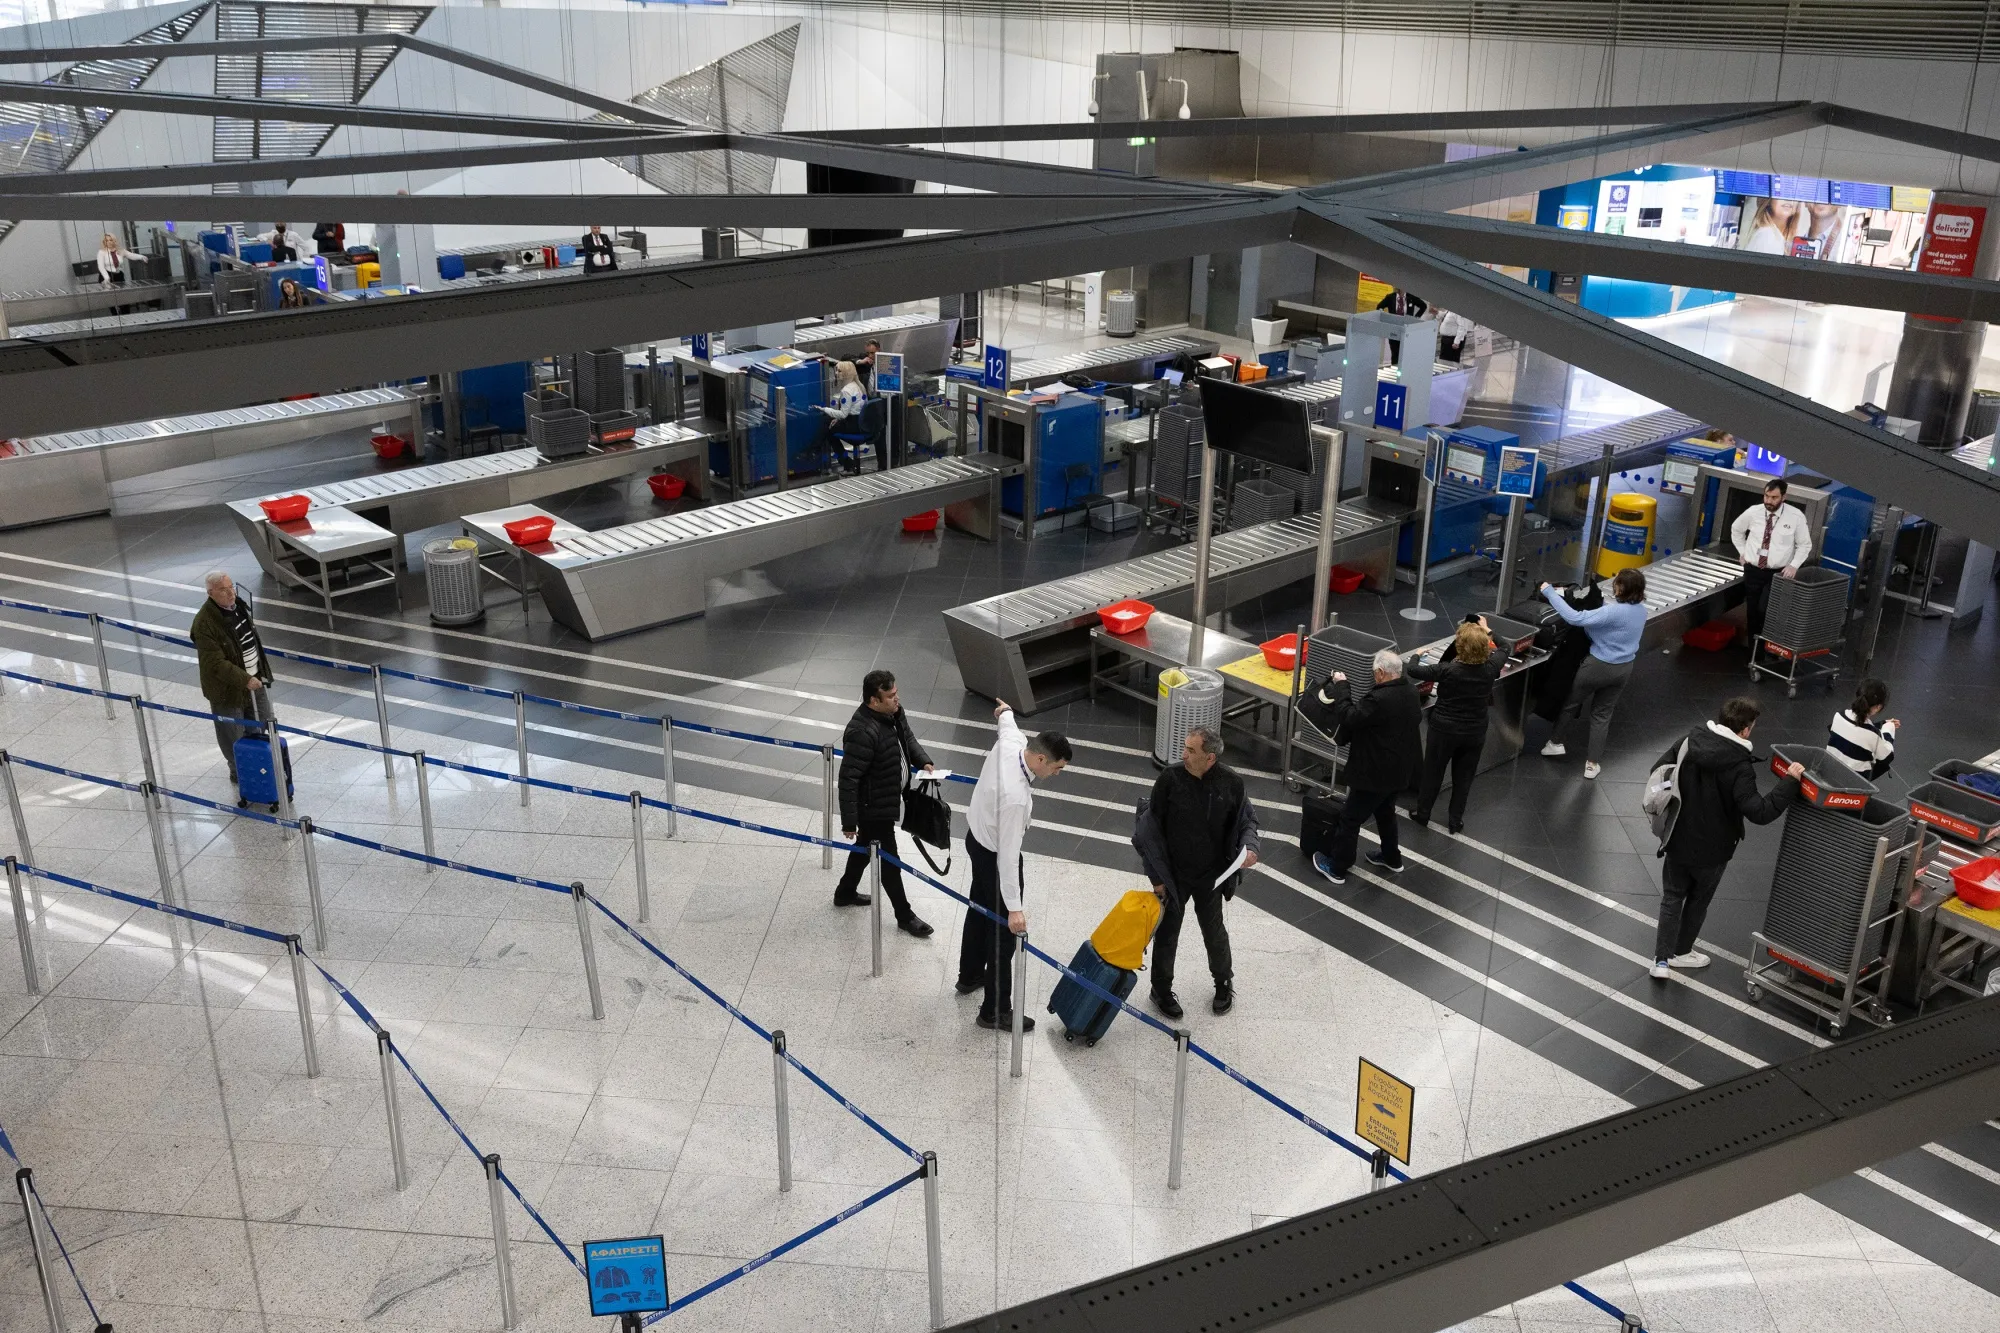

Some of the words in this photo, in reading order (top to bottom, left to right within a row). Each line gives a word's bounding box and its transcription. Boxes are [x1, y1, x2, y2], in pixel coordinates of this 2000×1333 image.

[1936, 223, 1969, 235] delivery
[317, 265, 325, 282] 15
[696, 334, 706, 350] 13
[988, 357, 1004, 380] 12
[1382, 394, 1400, 419] 11
[1768, 642, 1789, 655] Lenovo
[1829, 796, 1861, 806] Lenovo
[1914, 807, 1938, 820] Lenovo
[1365, 1121, 1373, 1129] to
[1374, 1125, 1400, 1146] Security
[1369, 1115, 1397, 1138] Entrance
[1367, 1129, 1398, 1153] Screening
[591, 1245, 659, 1257] ΑΦΑΙΡΕΣΤΕ
[750, 1253, 771, 1266] ATHENS
